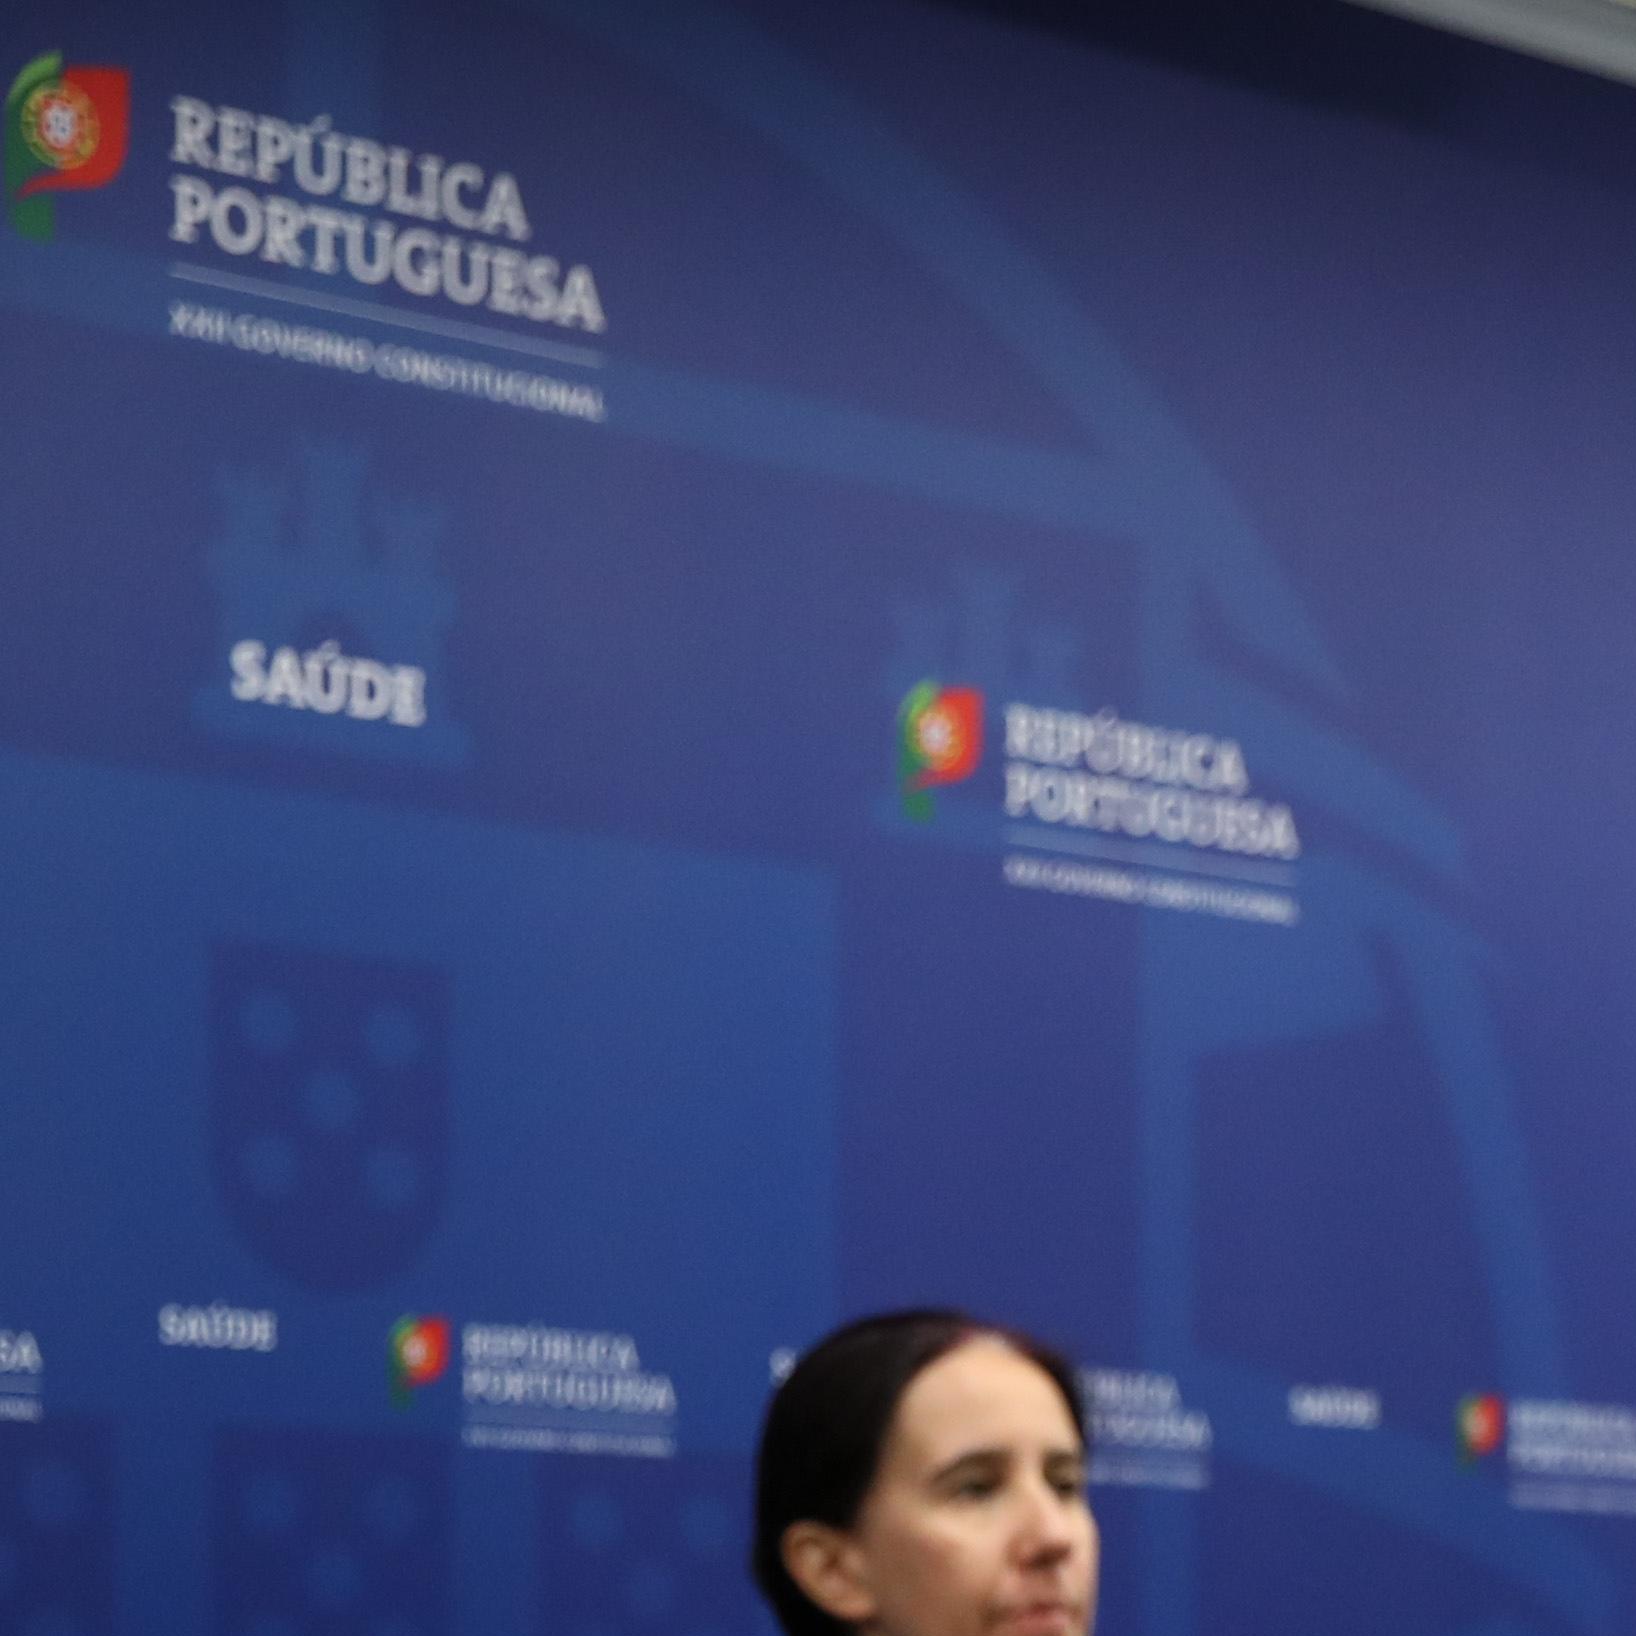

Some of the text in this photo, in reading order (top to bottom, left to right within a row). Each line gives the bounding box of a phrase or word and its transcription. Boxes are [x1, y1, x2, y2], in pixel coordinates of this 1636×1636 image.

[170, 95, 532, 242] REPÚBLICA
[169, 174, 607, 335] PORTUGUESA
[230, 313, 374, 374] GOVERNO
[230, 639, 427, 728] SAÚDE
[1004, 702, 1250, 798] REPÚBLICA
[1004, 760, 1299, 861] PORTUGUESA
